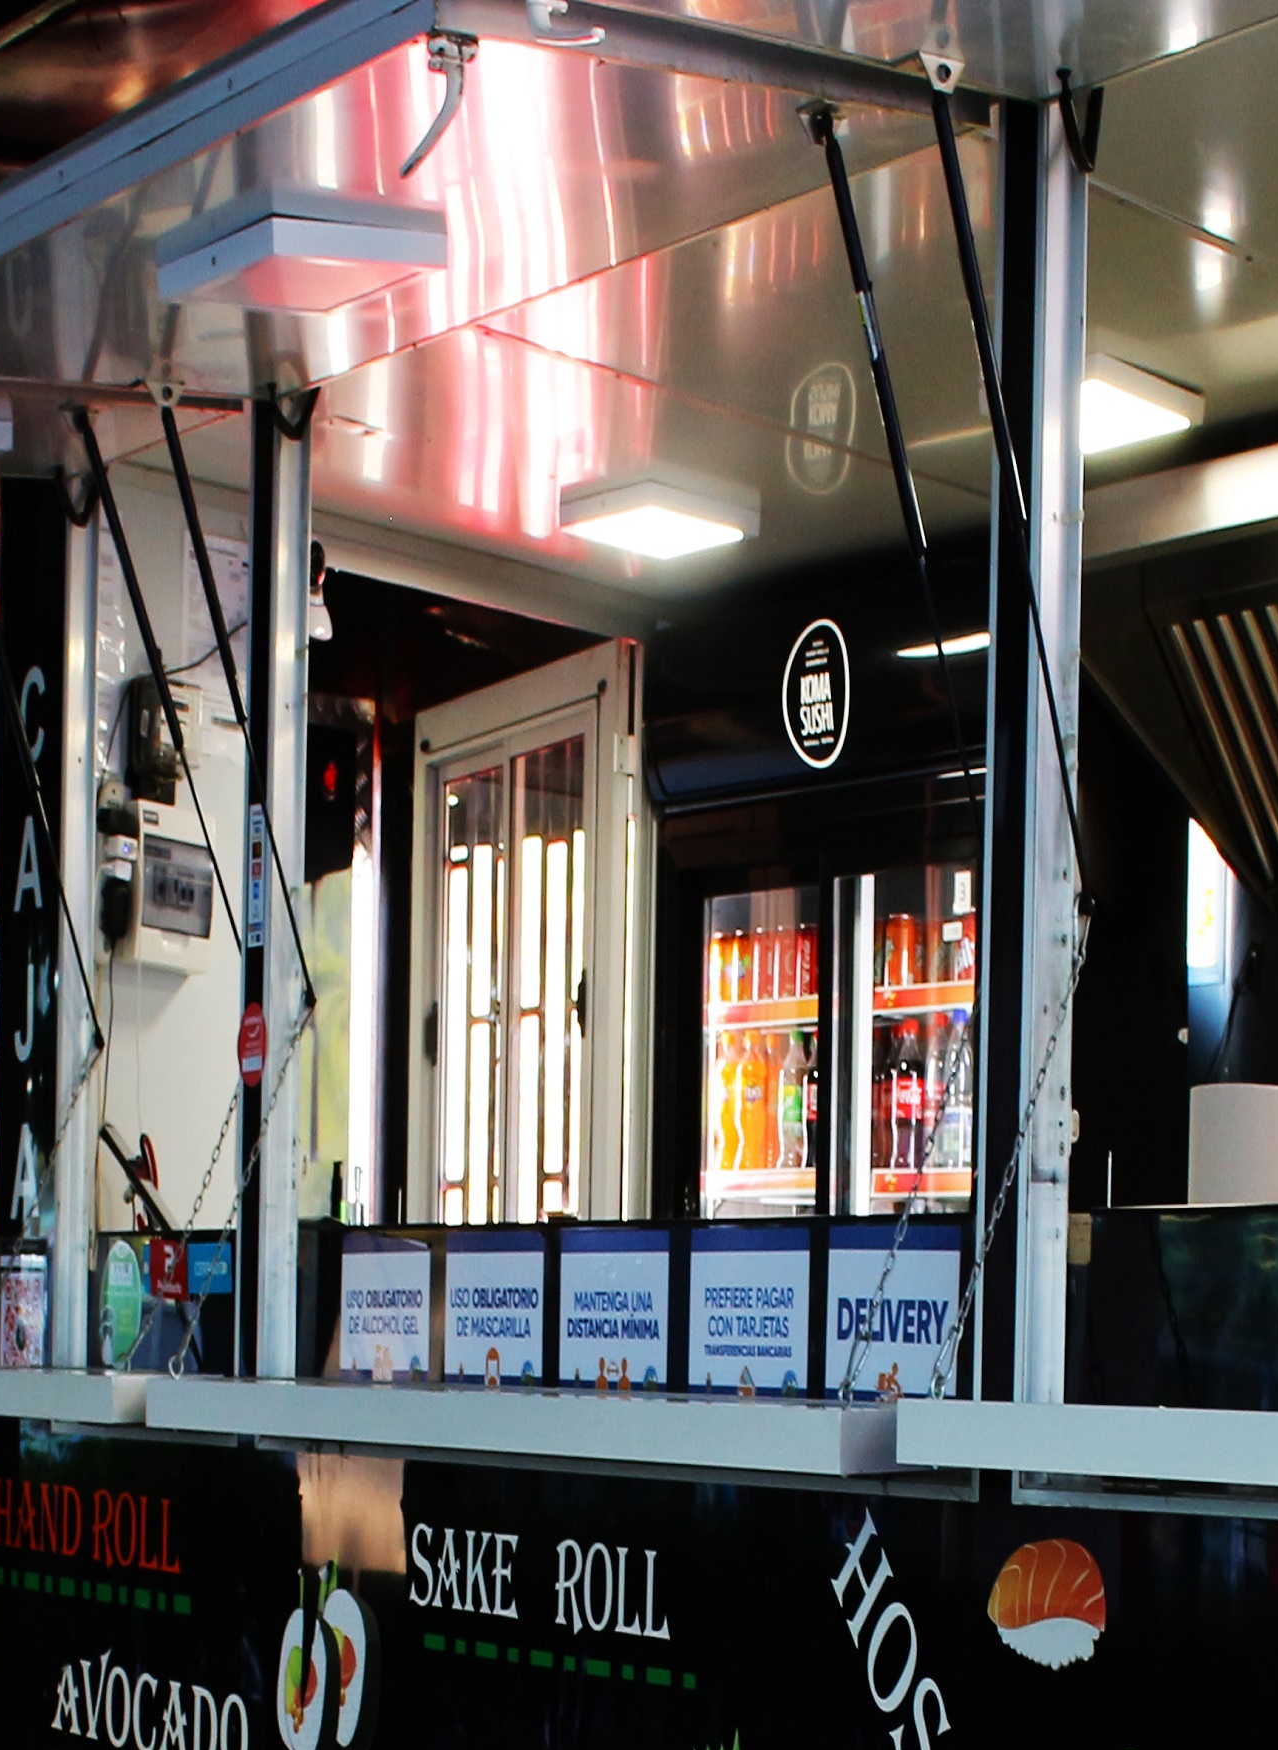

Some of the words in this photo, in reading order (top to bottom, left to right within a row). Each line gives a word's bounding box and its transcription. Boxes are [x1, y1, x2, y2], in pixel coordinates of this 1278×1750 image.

[800, 672, 832, 705] KOMA
[799, 701, 835, 736] SUSHI
[10, 664, 46, 1222] CAJA
[365, 1289, 423, 1309] OBLIGATORIO
[450, 1288, 470, 1308] USO
[472, 1287, 539, 1309] OBLIGATORIO
[574, 1291, 629, 1312] MANTENGA
[631, 1291, 653, 1312] UNA
[704, 1286, 754, 1308] PREFIERE
[755, 1287, 794, 1309] PAGAR
[348, 1316, 360, 1334] DE
[361, 1316, 402, 1334] ALCOHOL
[403, 1316, 419, 1335] GEL
[456, 1316, 468, 1337] DE
[471, 1316, 531, 1338] MASCARILLA
[567, 1318, 619, 1339] DISTANCIA
[622, 1314, 660, 1340] MÍNIMA
[708, 1316, 733, 1337] CON
[736, 1316, 789, 1339] TARJETAS
[837, 1297, 949, 1345] DELIVERY
[704, 1344, 756, 1358] TRANSFERENCIAS
[93, 1490, 179, 1573] ROLL
[410, 1524, 518, 1619] SAKE
[555, 1540, 670, 1639] ROLL
